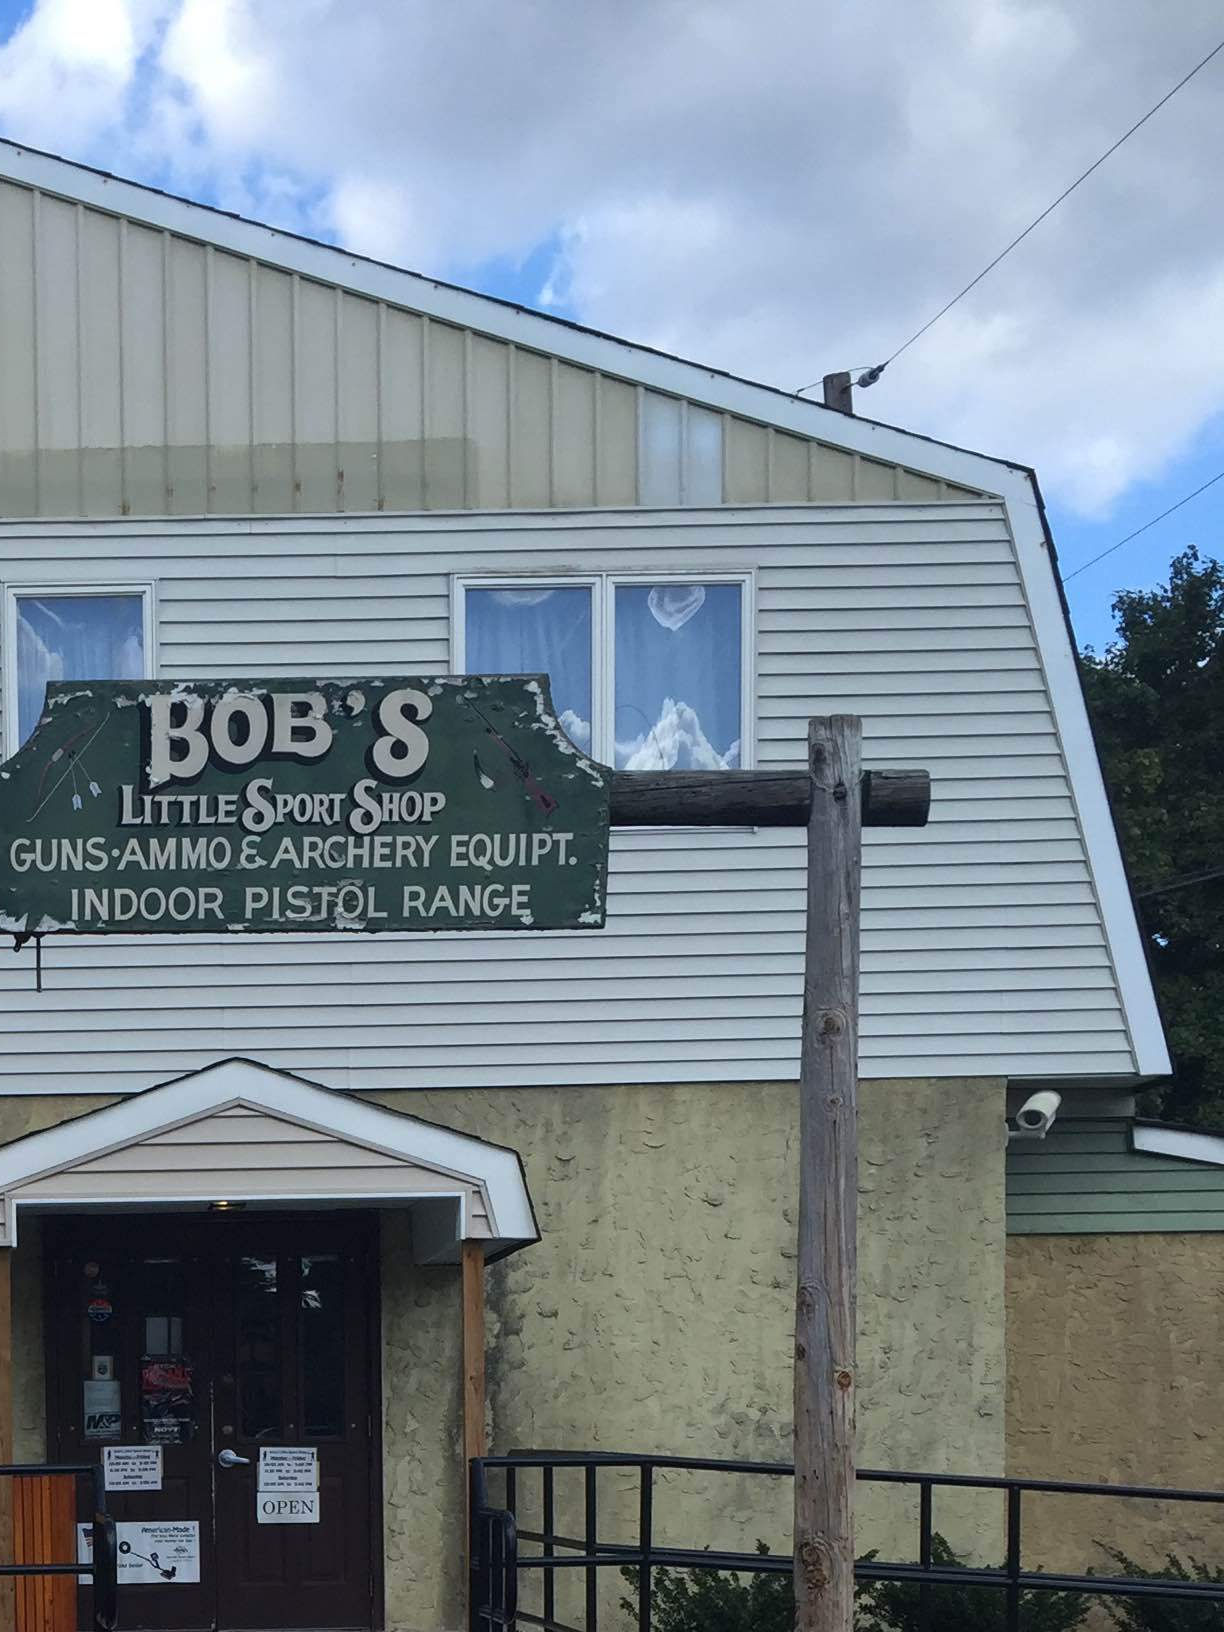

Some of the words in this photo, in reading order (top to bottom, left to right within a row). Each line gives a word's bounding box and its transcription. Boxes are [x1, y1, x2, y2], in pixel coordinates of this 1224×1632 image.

[149, 687, 434, 788] BOB'S
[122, 786, 238, 826] LITTLE
[242, 778, 347, 833] SPORT
[353, 778, 447, 835] SHOP
[239, 836, 267, 869] &
[273, 834, 440, 870] ARCHERY
[449, 832, 578, 868] EQUIPT.
[71, 887, 224, 922] INDOOR
[245, 884, 388, 921] PISTOL
[402, 884, 532, 918] RANGE
[262, 1500, 314, 1515] OPEN
